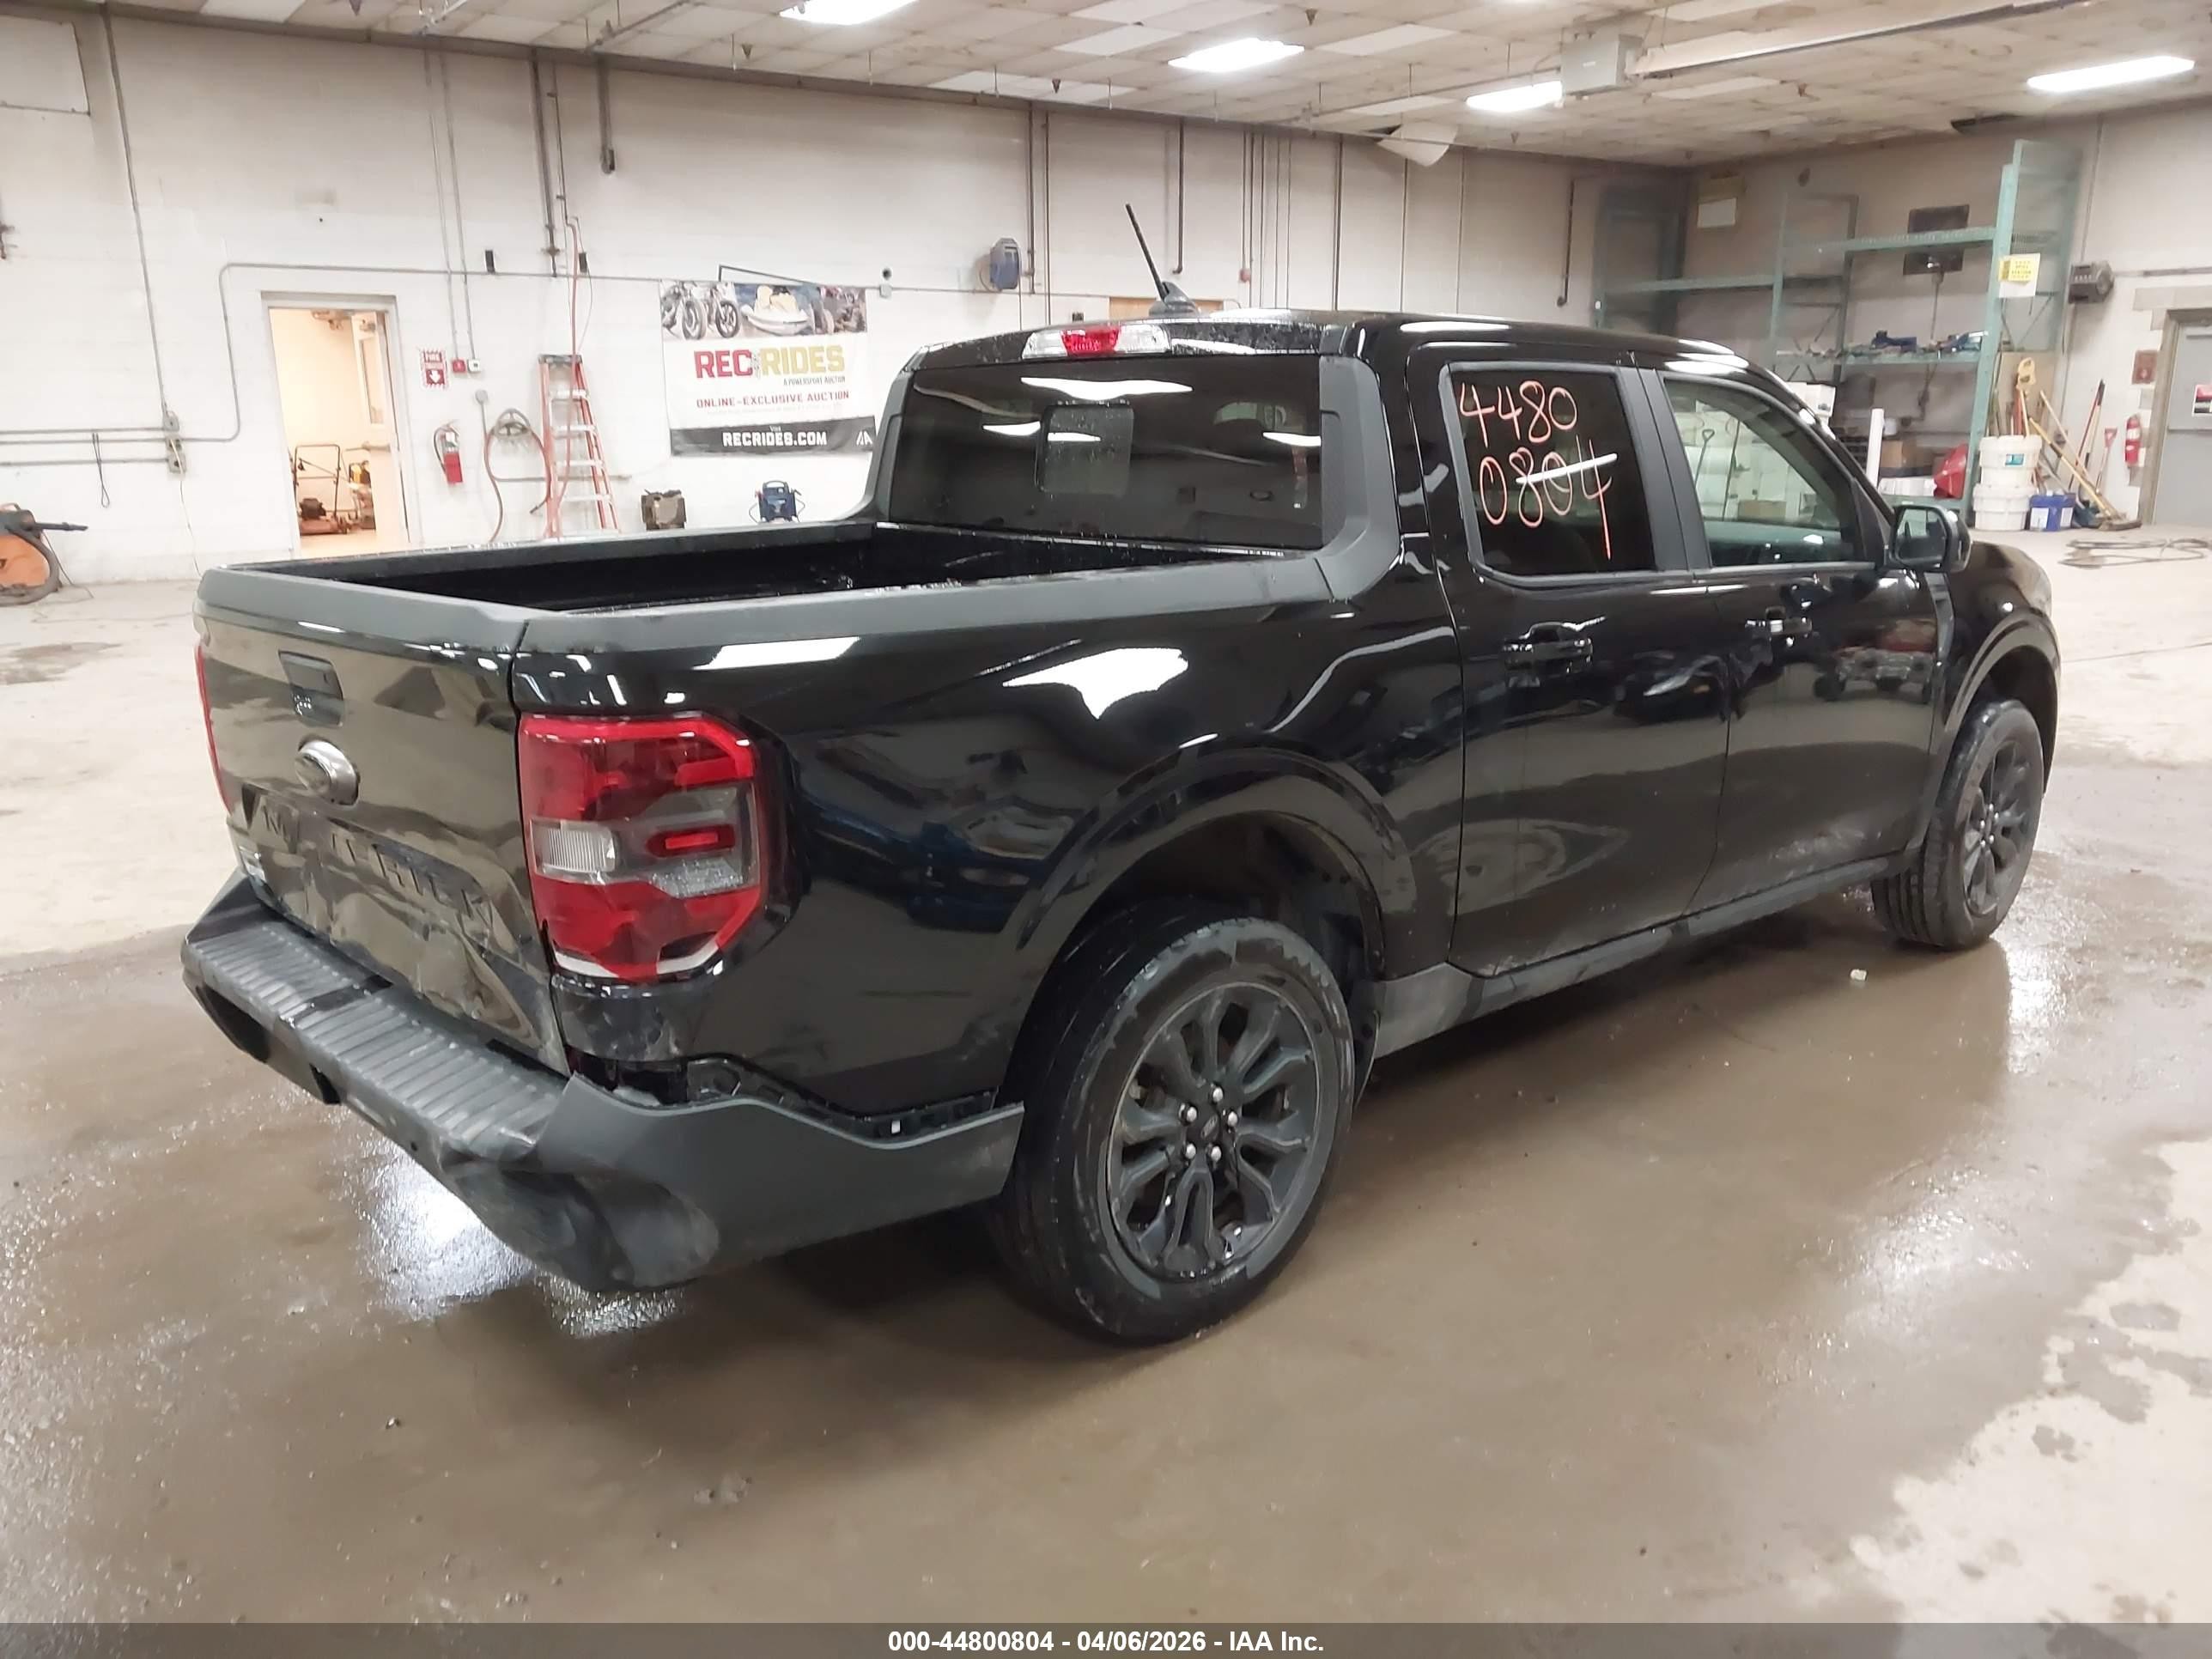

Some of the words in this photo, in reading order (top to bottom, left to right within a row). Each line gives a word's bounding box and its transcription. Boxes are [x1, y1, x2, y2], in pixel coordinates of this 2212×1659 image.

[694, 349, 753, 379] REC
[759, 345, 845, 376] RIDES
[807, 390, 849, 402] AUCTION
[1460, 380, 1577, 447] 4480
[722, 431, 827, 447] RECRIDES.COM
[1480, 434, 1613, 560] 0804
